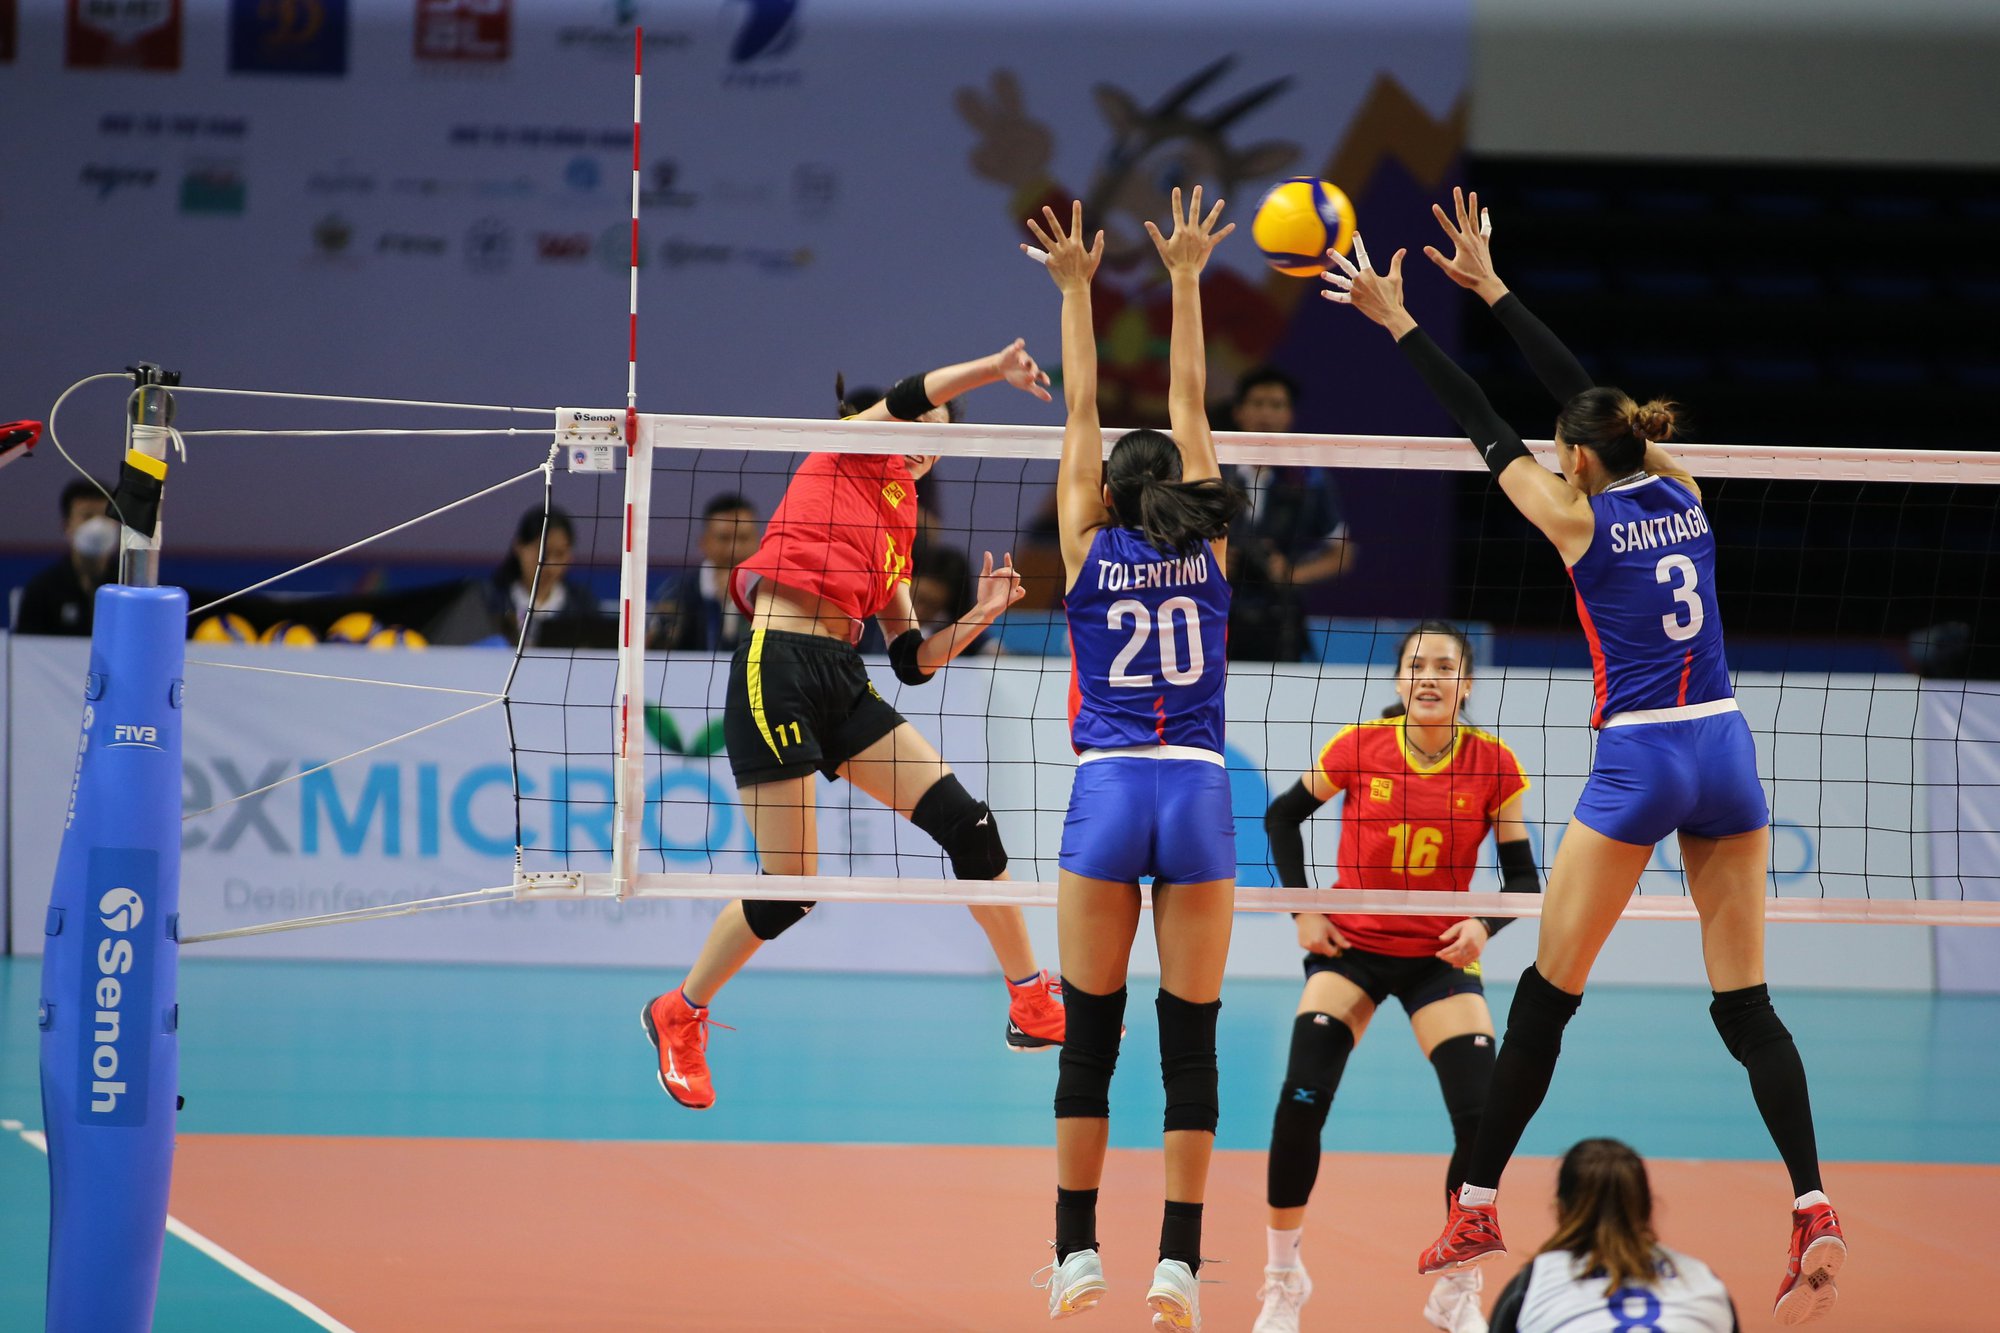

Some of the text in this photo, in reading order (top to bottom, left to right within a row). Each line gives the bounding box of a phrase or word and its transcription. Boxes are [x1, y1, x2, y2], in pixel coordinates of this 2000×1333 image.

[583, 413, 616, 422] Senoh
[1610, 505, 1708, 553] SANTIAGO
[1097, 553, 1208, 592] TOLENTINO
[1655, 553, 1704, 641] 3
[1106, 596, 1204, 688] 20
[114, 724, 157, 742] FIVB
[775, 720, 802, 747] 11
[1387, 823, 1443, 877] 16
[91, 937, 134, 1113] Senoh
